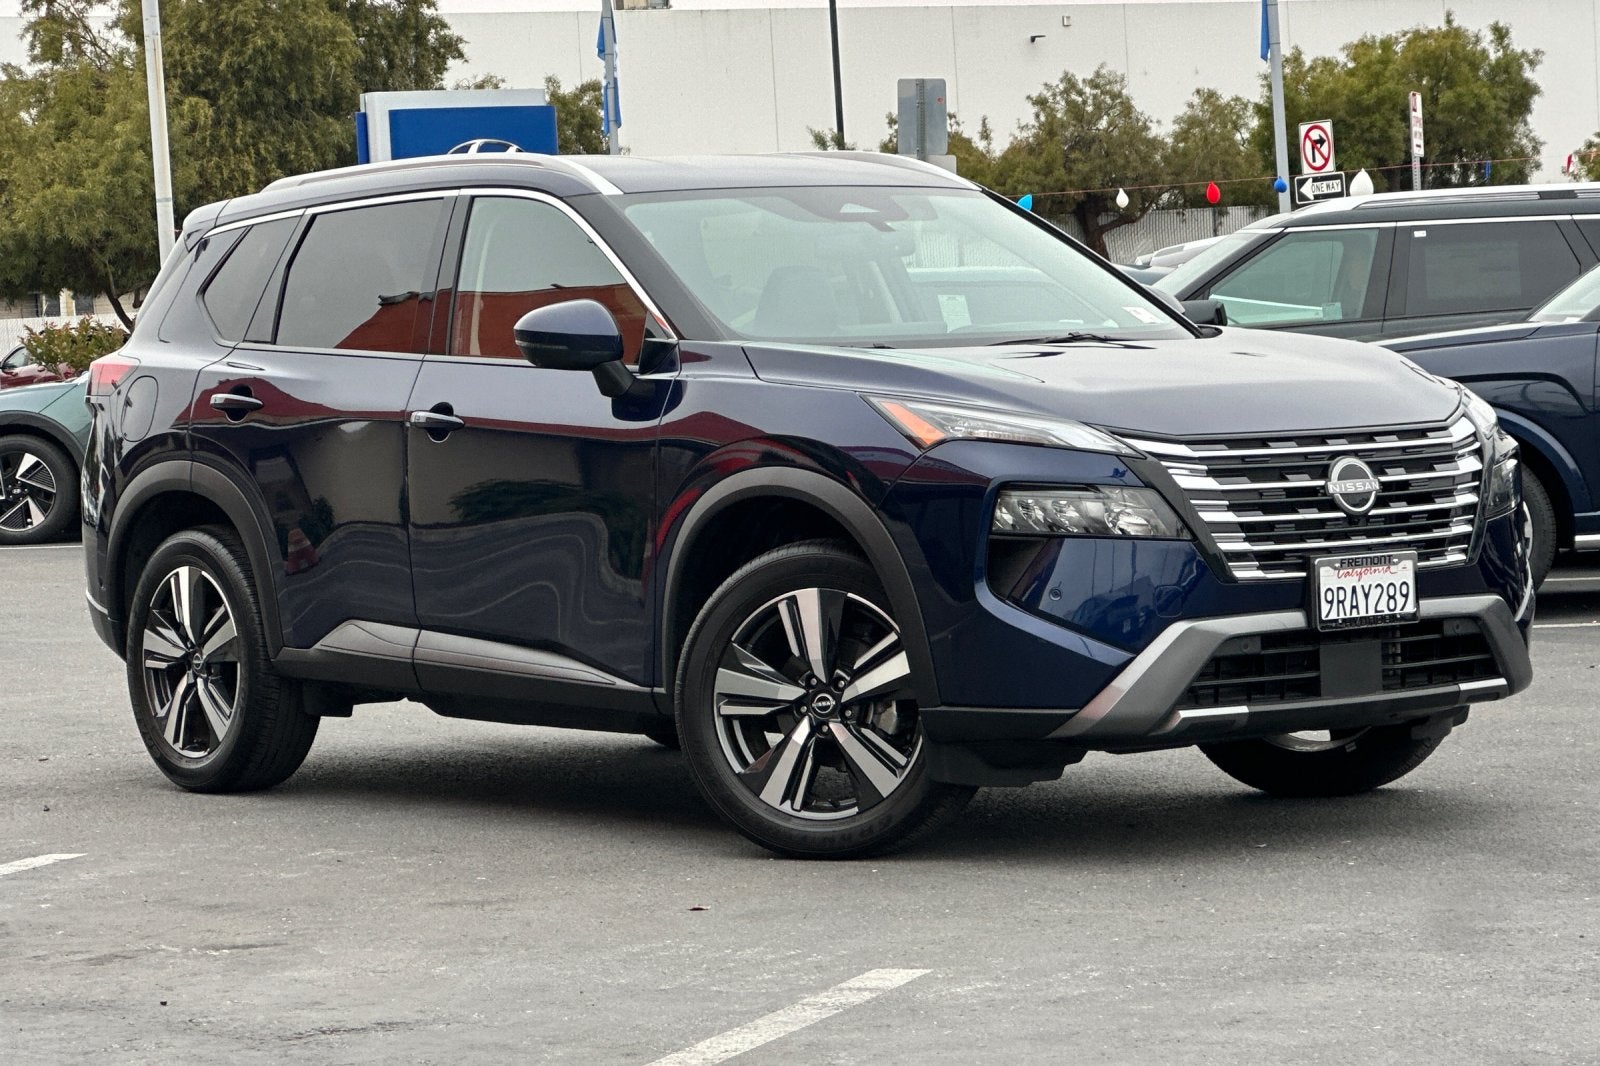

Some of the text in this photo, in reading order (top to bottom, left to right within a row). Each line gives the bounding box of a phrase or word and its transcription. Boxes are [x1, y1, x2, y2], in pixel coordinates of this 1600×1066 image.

[1311, 181, 1341, 194] ONE WAY
[1330, 481, 1379, 493] NISSAN
[1340, 554, 1393, 568] FREMONT
[1336, 565, 1398, 581] California
[1324, 581, 1410, 618] 9RAY289
